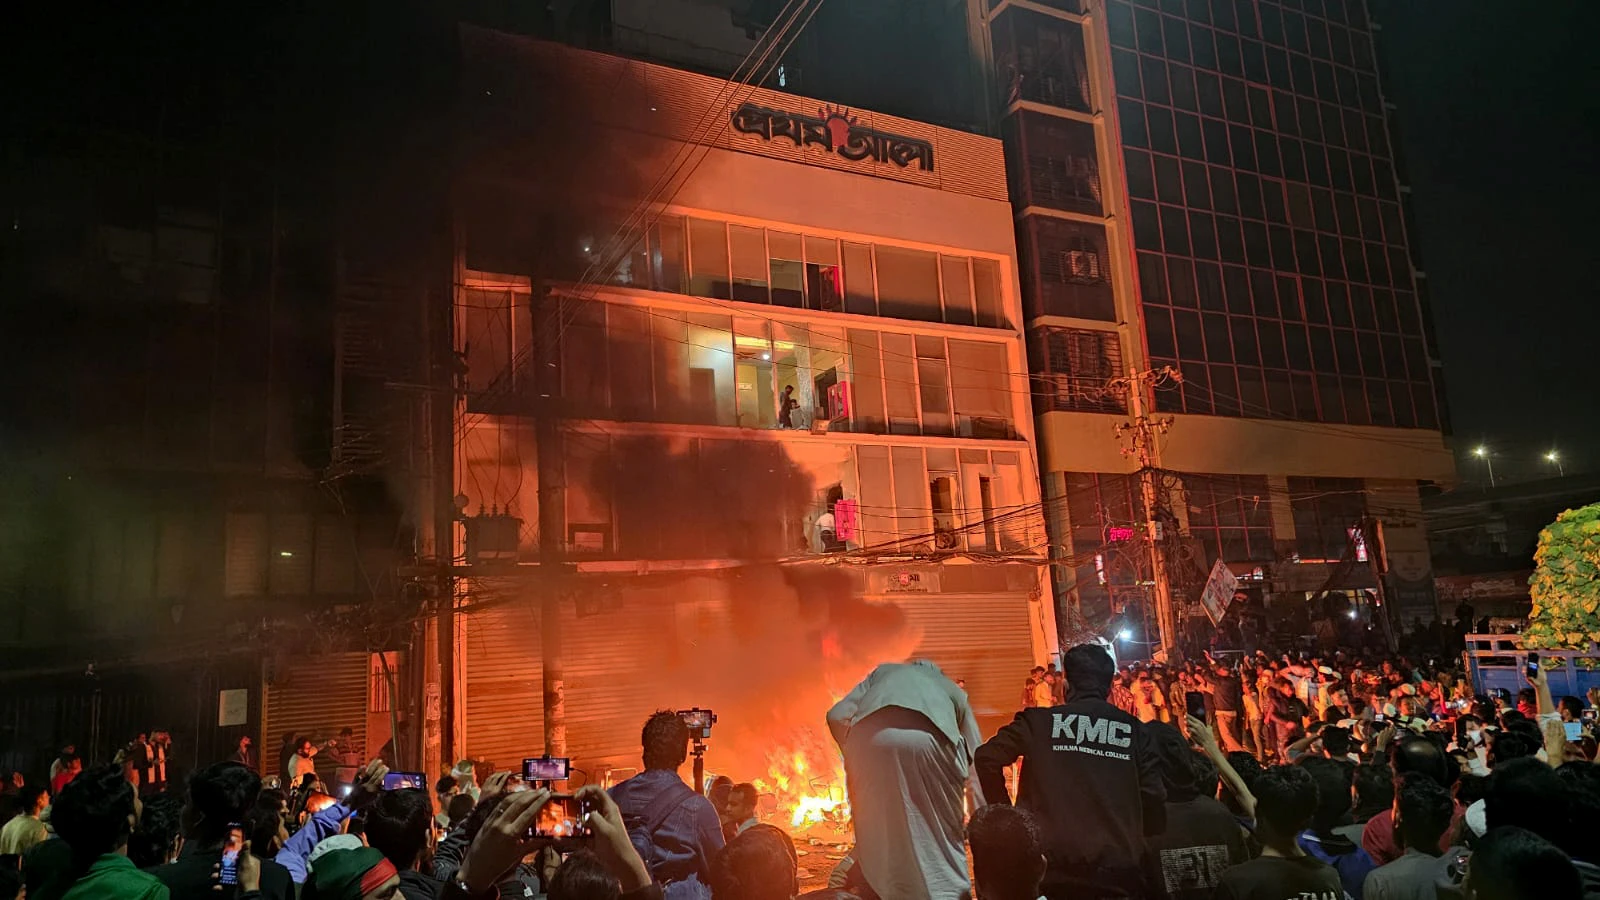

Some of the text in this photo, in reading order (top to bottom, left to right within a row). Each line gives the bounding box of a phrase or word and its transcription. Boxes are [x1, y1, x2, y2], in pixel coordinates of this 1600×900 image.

[731, 102, 934, 173] প্রথম আলো
[1051, 713, 1132, 748] KMC
[1052, 744, 1132, 761] KHULNA MEDICAL COLLEGE
